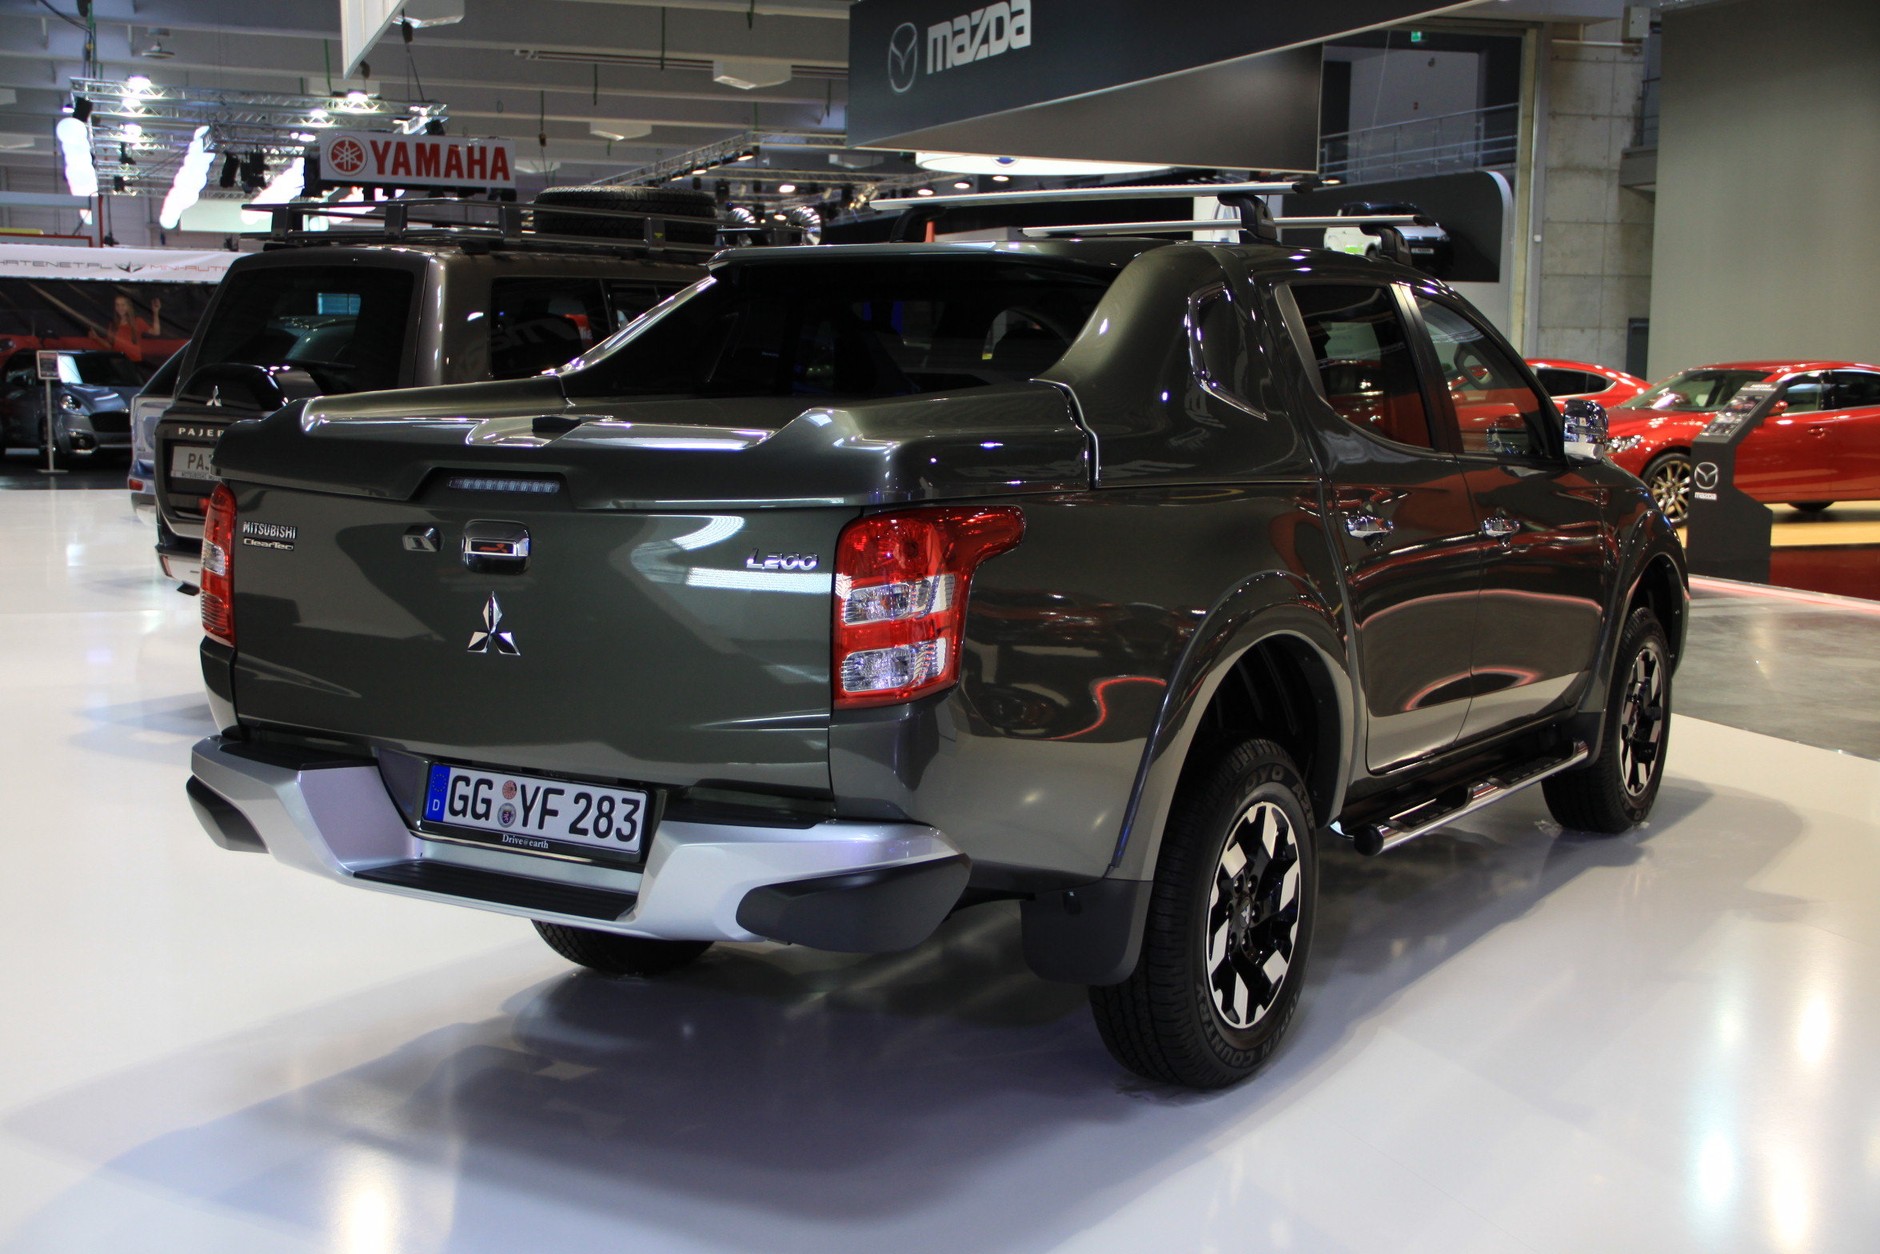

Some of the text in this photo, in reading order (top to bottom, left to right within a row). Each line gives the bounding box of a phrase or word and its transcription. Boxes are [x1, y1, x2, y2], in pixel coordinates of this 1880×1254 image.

[370, 140, 510, 180] YAMAHA
[243, 521, 296, 539] MITSUBISHI
[243, 538, 294, 551] ClearTec
[746, 547, 819, 571] L200
[432, 799, 440, 811] D
[448, 774, 641, 842] GG YF 283
